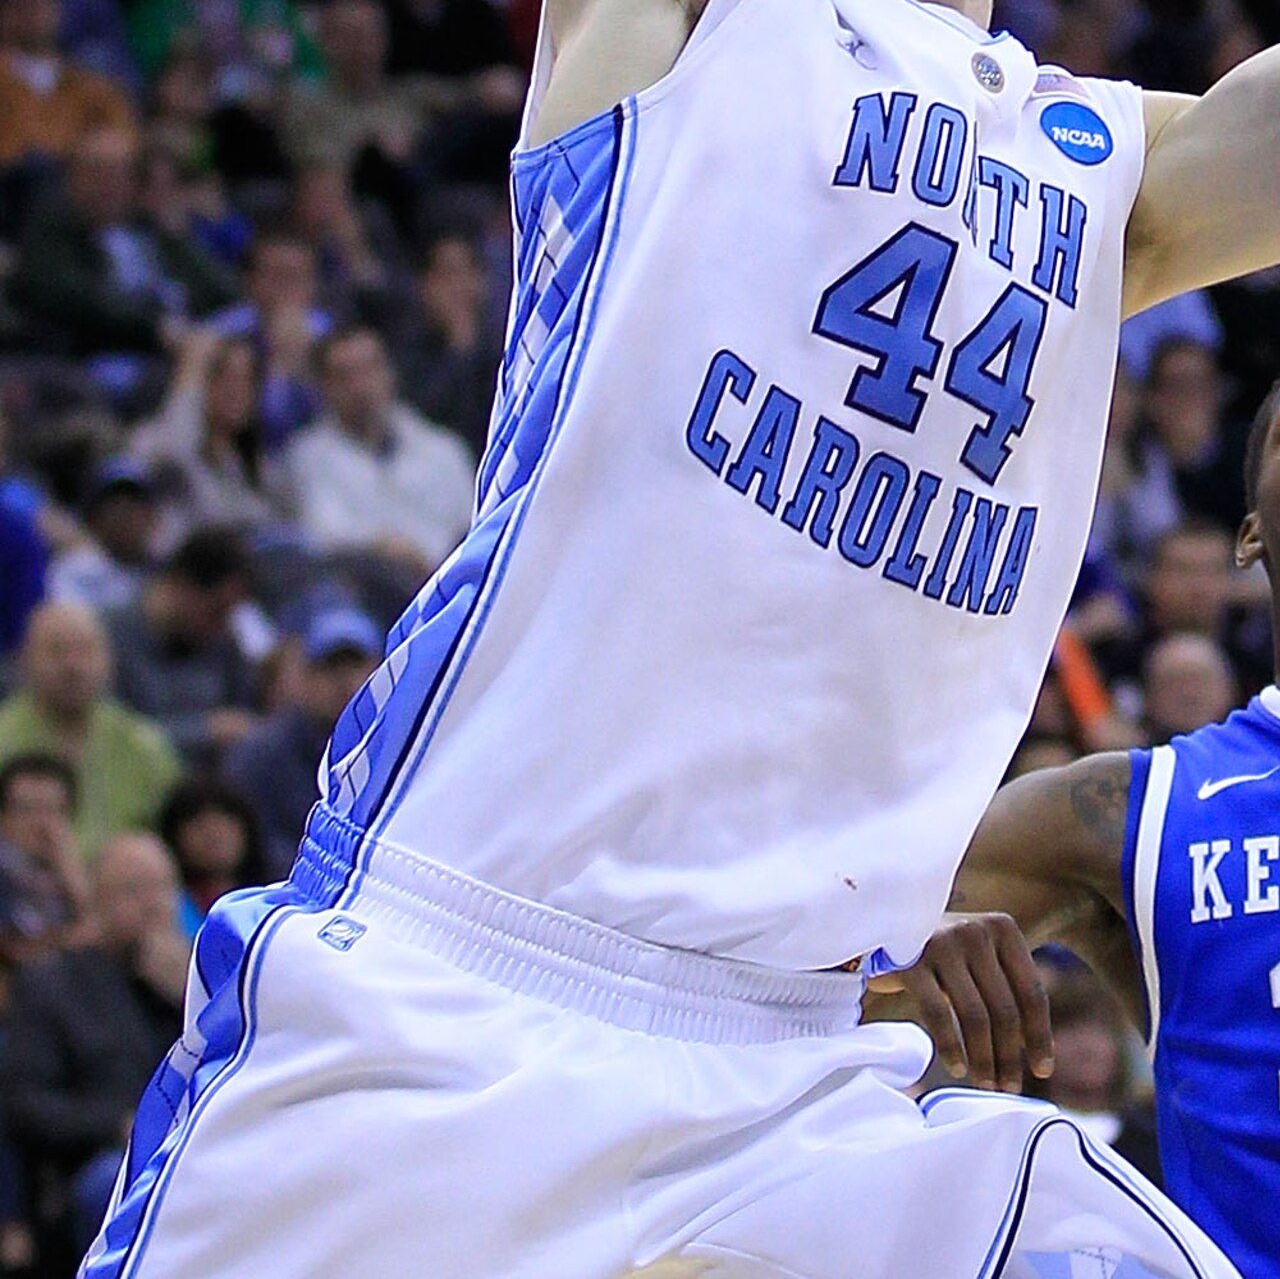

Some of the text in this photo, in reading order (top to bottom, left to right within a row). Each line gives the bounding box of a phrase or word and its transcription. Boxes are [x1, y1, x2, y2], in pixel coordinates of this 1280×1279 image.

[833, 91, 1088, 309] NOTH
[1051, 126, 1105, 150] NCAA
[812, 220, 1049, 486] 44
[685, 349, 1039, 615] CAROLINA
